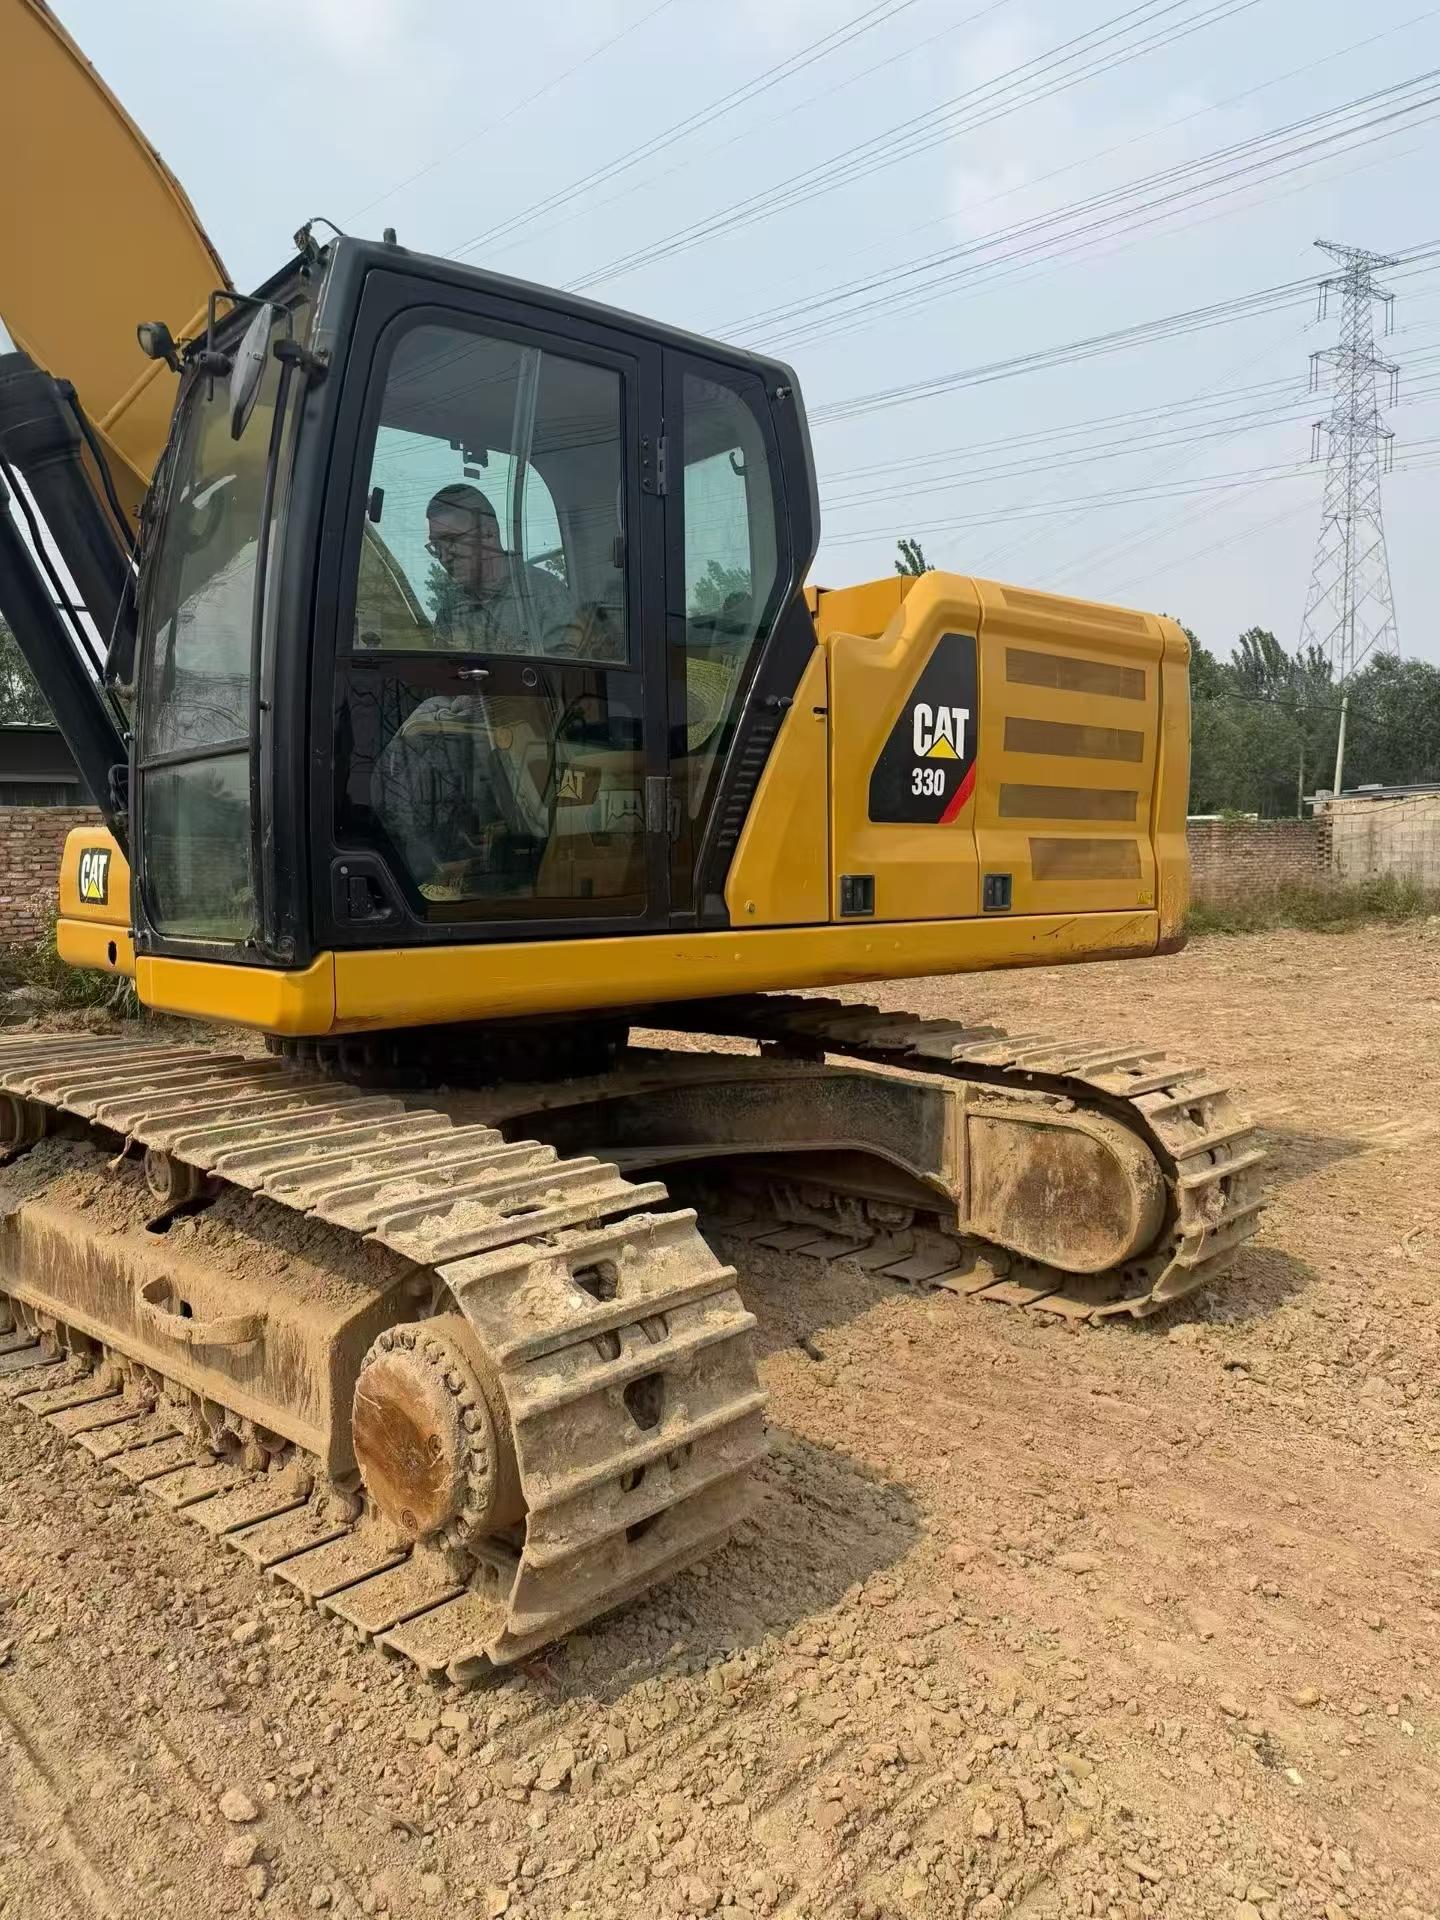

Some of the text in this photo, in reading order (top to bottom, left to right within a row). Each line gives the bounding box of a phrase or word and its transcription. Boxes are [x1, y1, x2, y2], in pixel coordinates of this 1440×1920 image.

[913, 703, 970, 760] CAT
[555, 768, 586, 800] AT
[911, 767, 946, 796] 330
[80, 853, 108, 899] CAT
